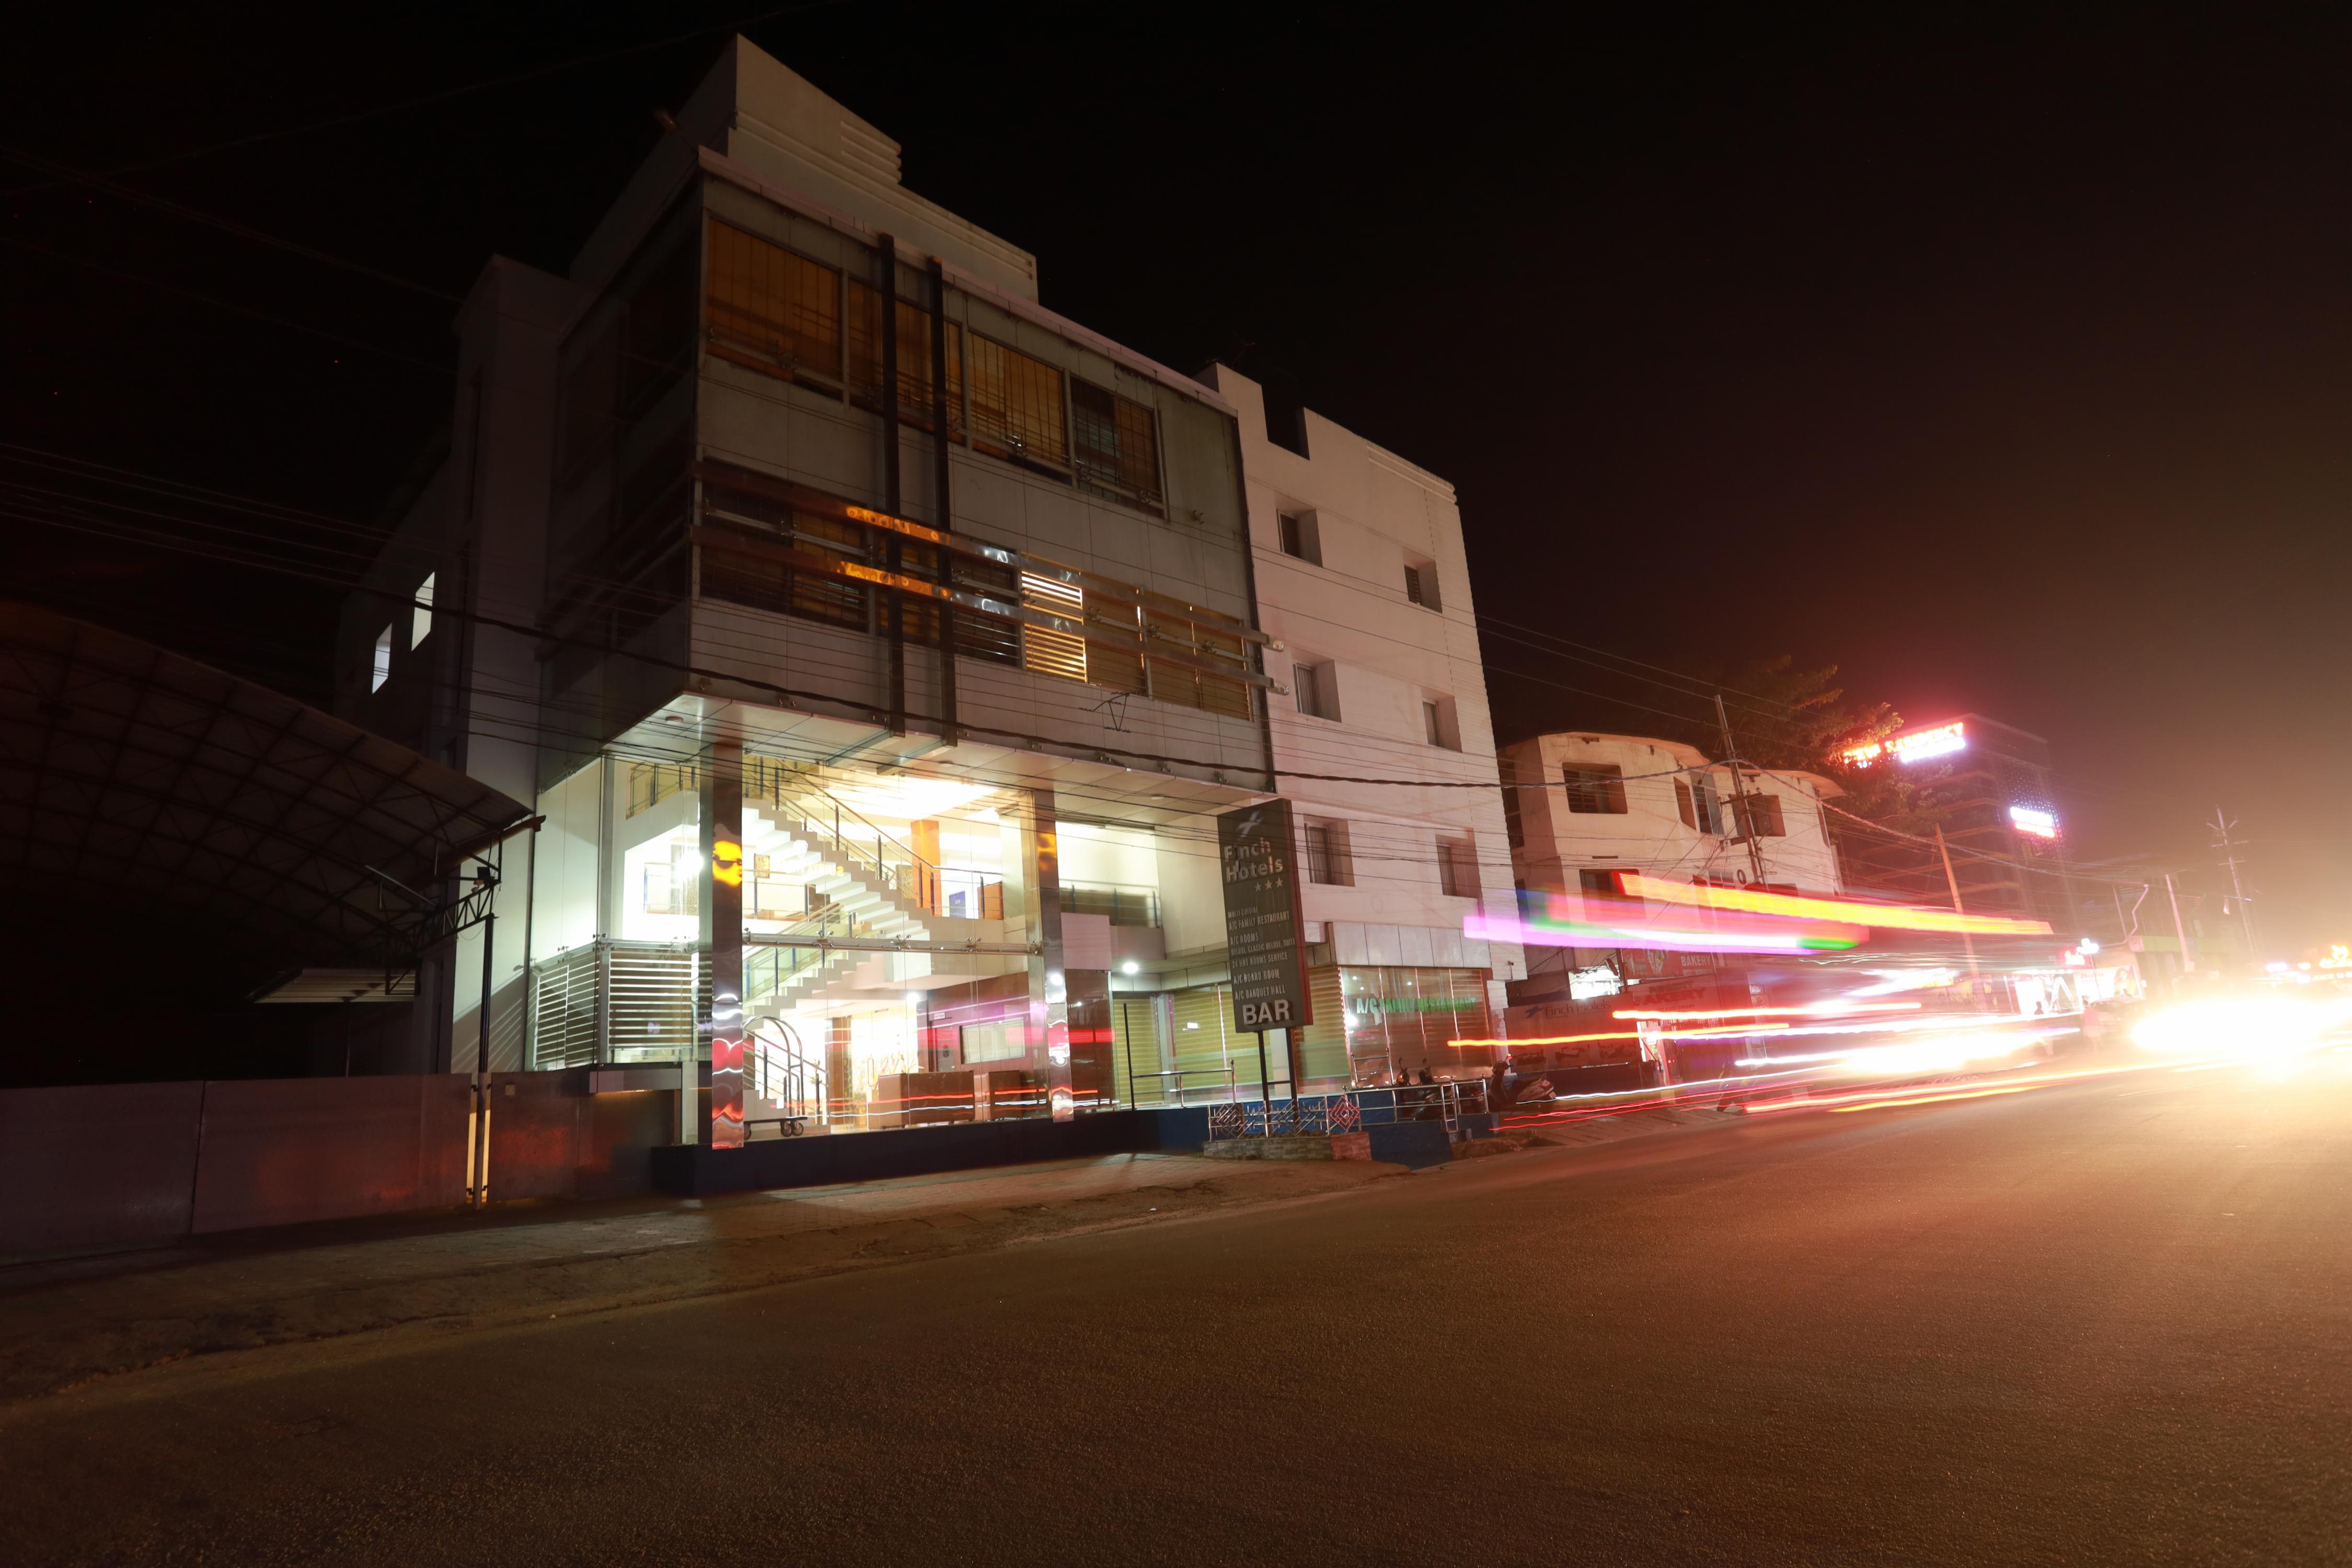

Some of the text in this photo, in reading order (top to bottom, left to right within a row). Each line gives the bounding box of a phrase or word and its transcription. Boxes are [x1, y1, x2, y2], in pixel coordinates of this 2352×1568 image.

[1226, 856, 1284, 883] Hotels
[1228, 906, 1259, 918] MULTI CUISINE
[1229, 910, 1289, 931] A/C FAMILY RESTAURANT
[1230, 932, 1259, 946] A/C ROOMS
[1248, 943, 1265, 953] CLASSIC
[1284, 938, 1296, 947] SUITE
[1232, 951, 1288, 969] 24 HRS ROOMS SERVICE
[1681, 955, 1711, 966] BAKERY
[1234, 968, 1280, 985] A/C BOARD ROOM
[1235, 984, 1286, 1001] A/C BANQUET HALL
[1242, 999, 1290, 1025] BAR
[1356, 998, 1377, 1014] A/C
[1545, 999, 1611, 1017] Finch Hotels
